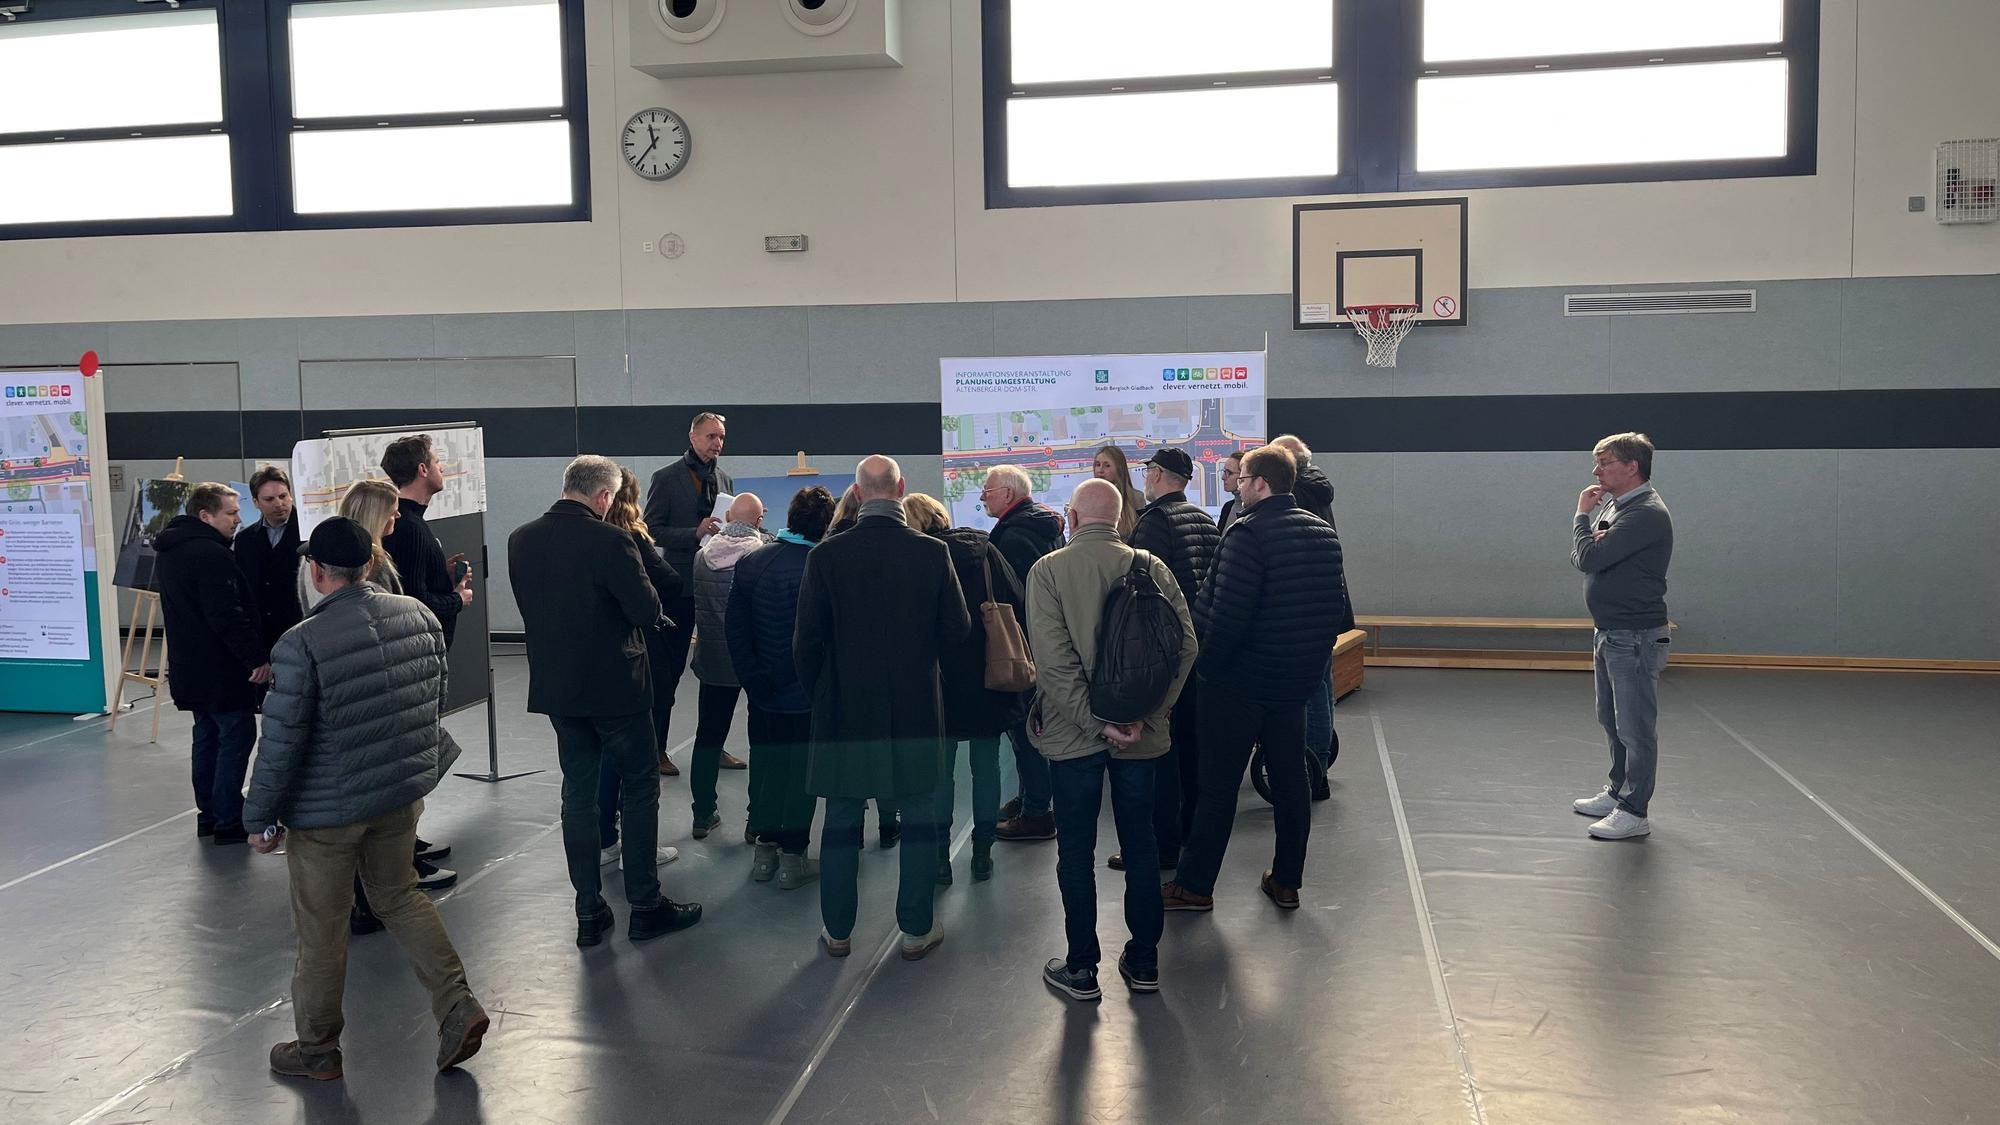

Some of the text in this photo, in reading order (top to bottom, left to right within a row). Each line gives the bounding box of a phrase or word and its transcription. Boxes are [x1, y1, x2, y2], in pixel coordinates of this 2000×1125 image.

[955, 370, 1072, 378] INFORMATIONSVERANSTALTUNG
[1162, 382, 1186, 390] clever.
[1224, 381, 1248, 389] mobil.
